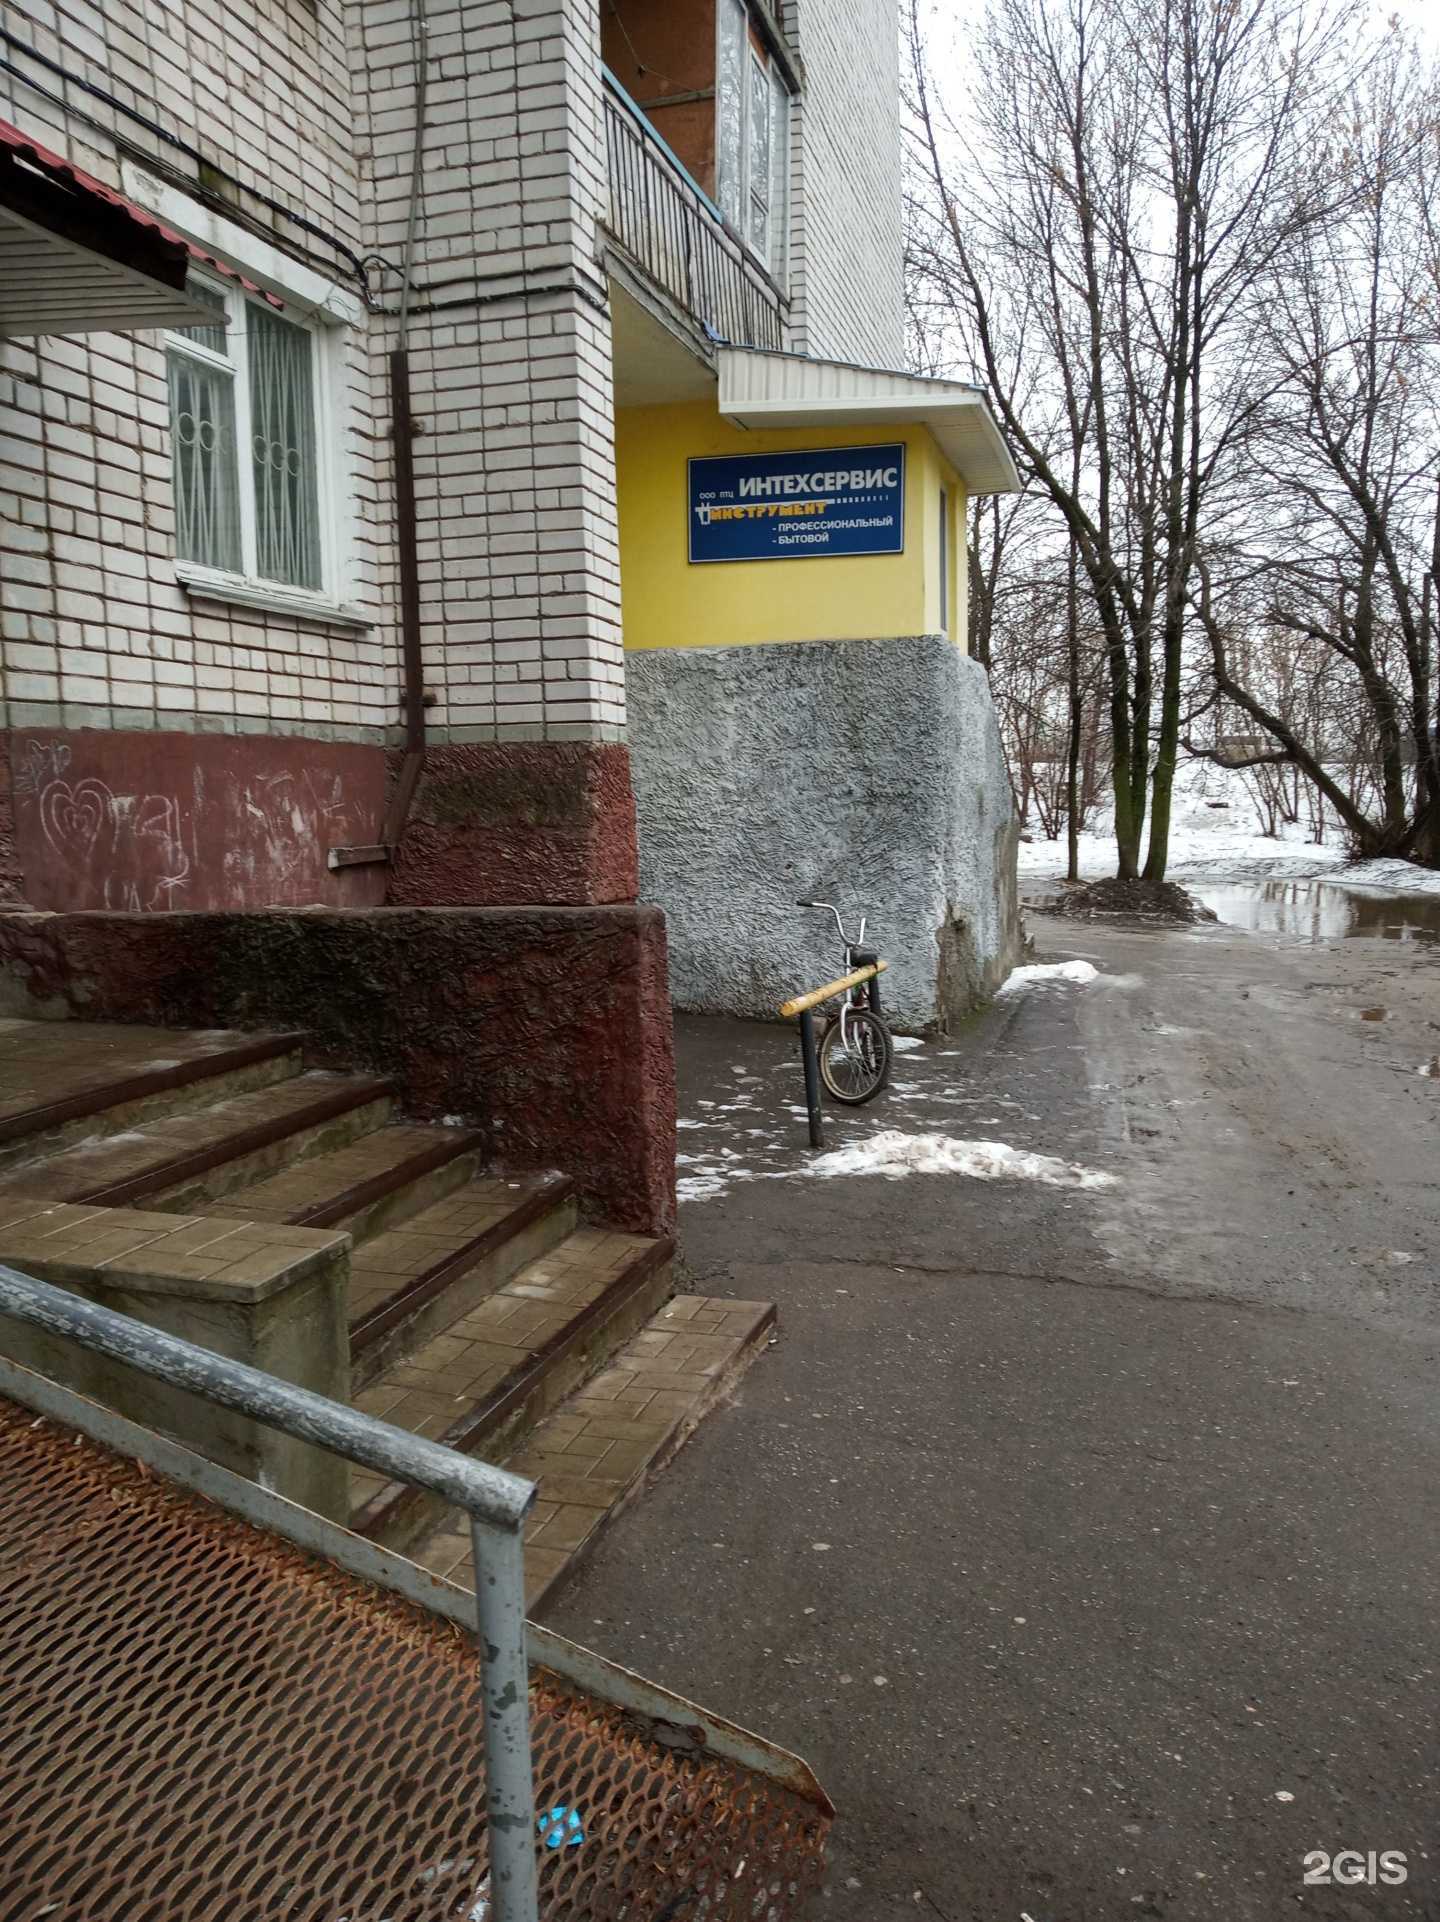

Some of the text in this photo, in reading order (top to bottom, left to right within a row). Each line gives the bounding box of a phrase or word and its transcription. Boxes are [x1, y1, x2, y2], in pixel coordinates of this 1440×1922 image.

[699, 491, 716, 499] ООО
[739, 467, 898, 497] ИНТЕХСЕРВИС
[710, 502, 827, 521] ИНСТРУМЕНТ
[778, 516, 893, 532] ПРОФЕССИОНАЛЬНЫЙ
[778, 532, 829, 545] БЫТОВОЙ
